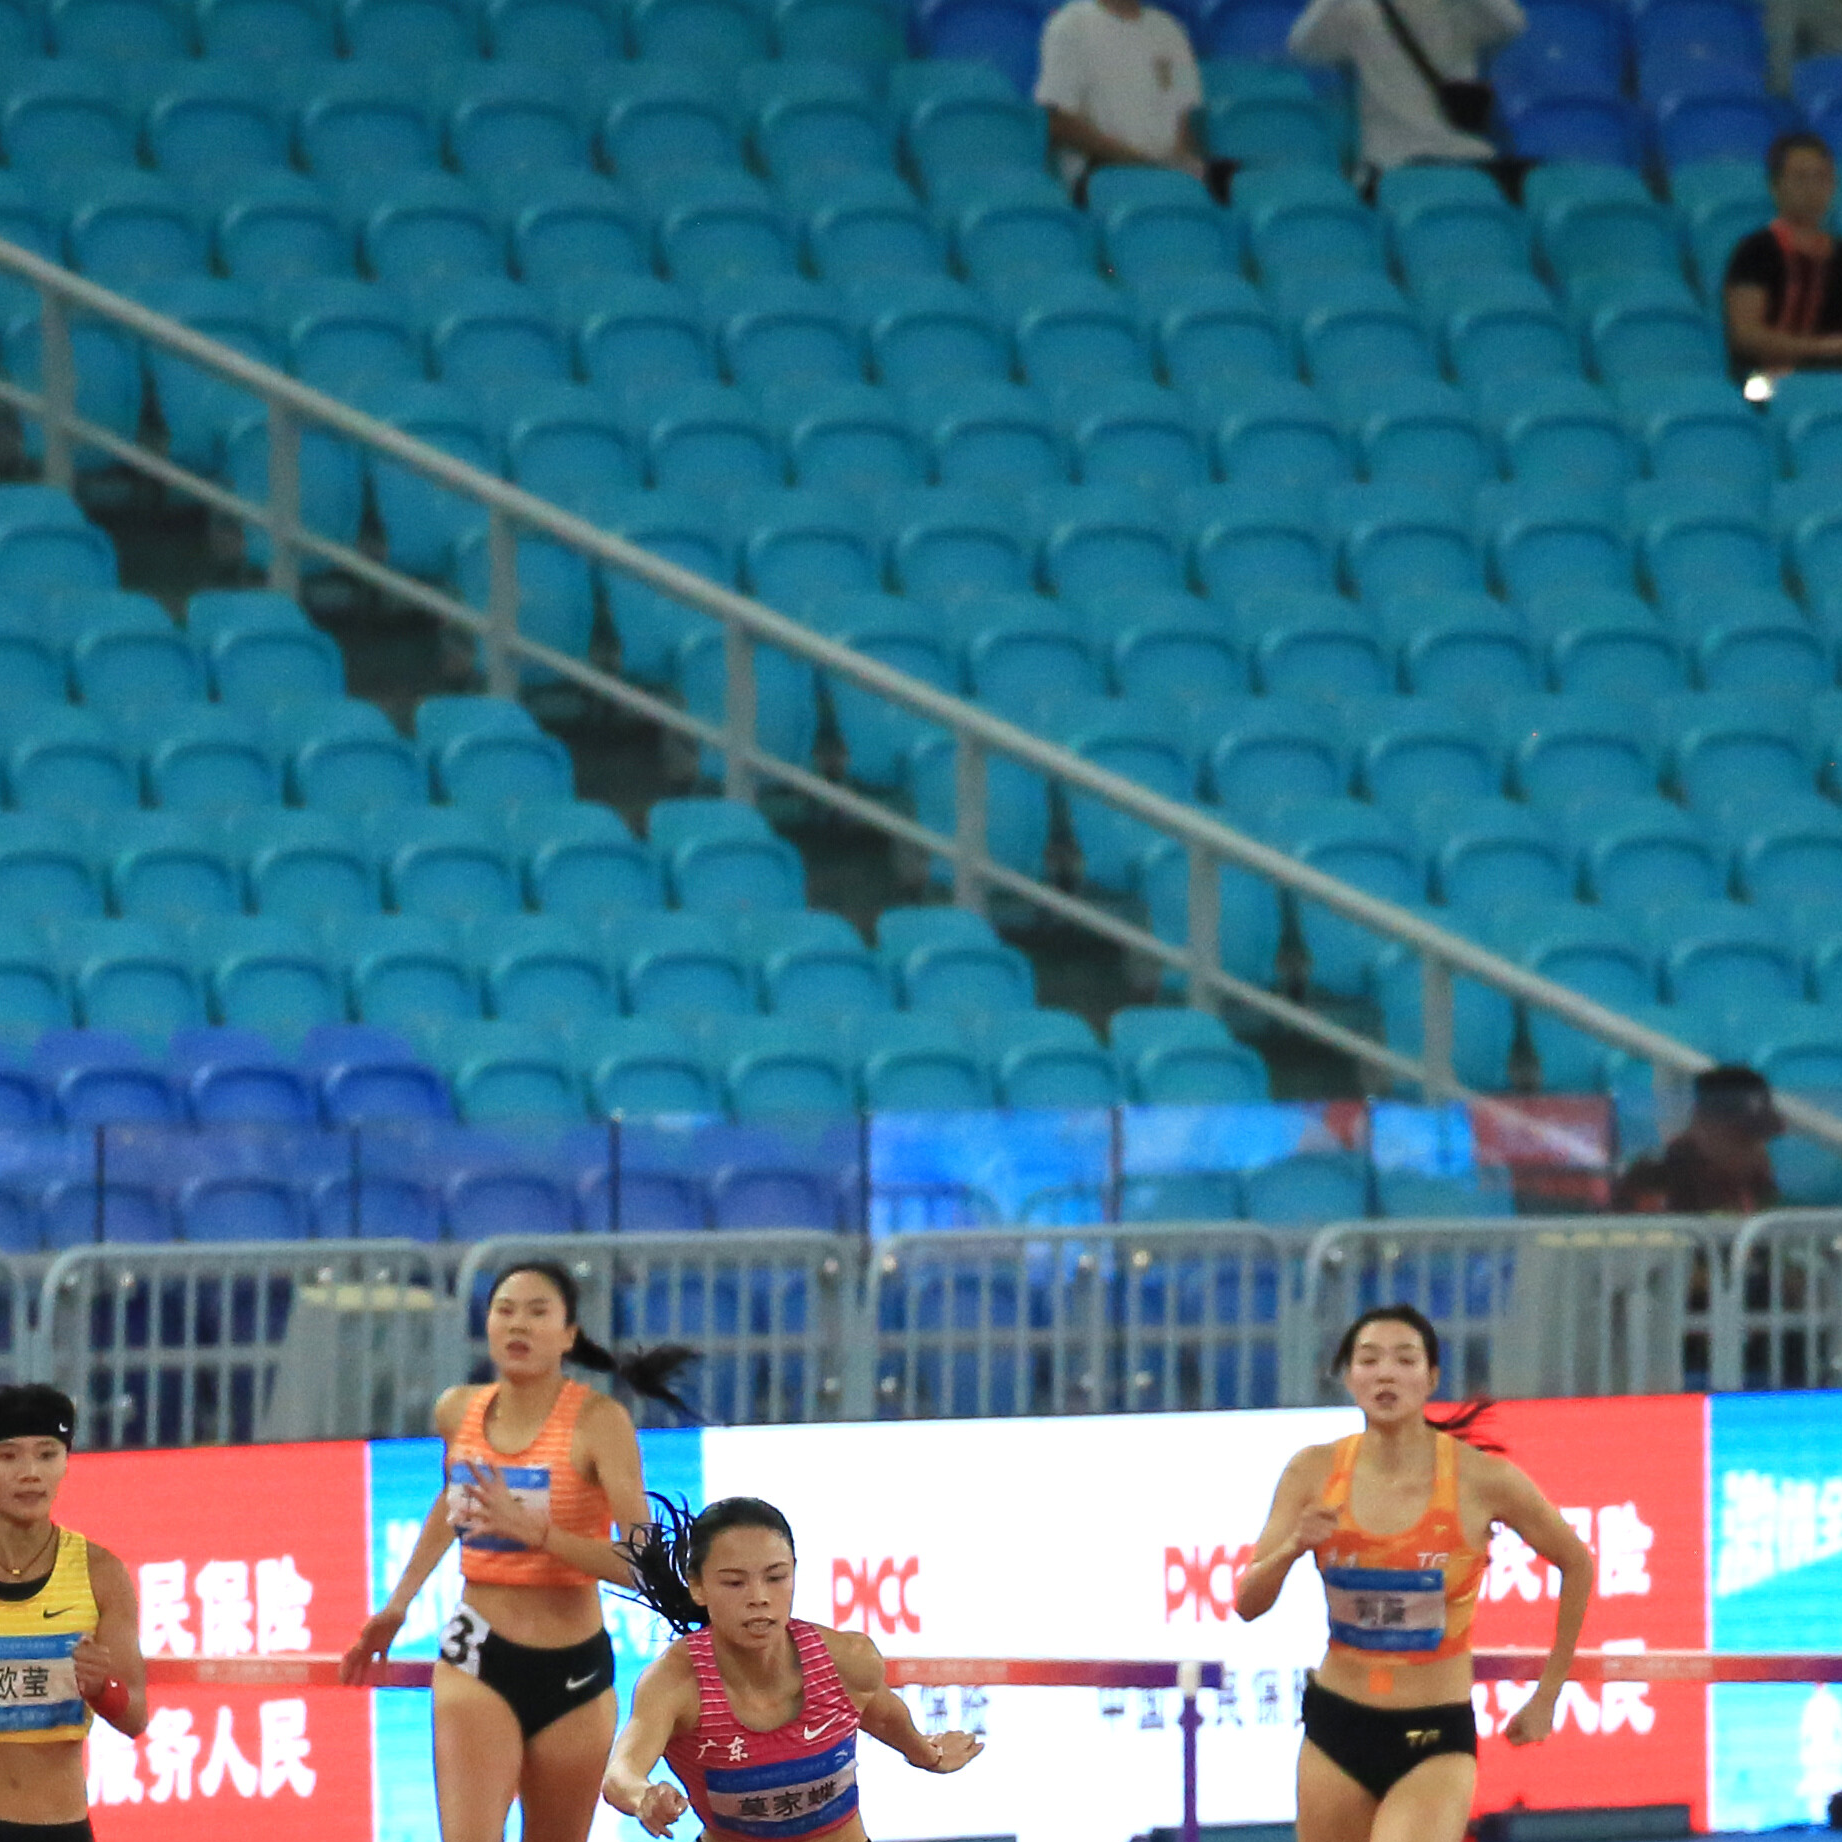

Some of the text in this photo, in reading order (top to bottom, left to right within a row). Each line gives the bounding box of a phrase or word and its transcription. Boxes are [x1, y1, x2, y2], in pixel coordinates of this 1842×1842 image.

[832, 1556, 920, 1634] PICC
[442, 1615, 474, 1665] 3
[697, 1736, 749, 1762] 广东
